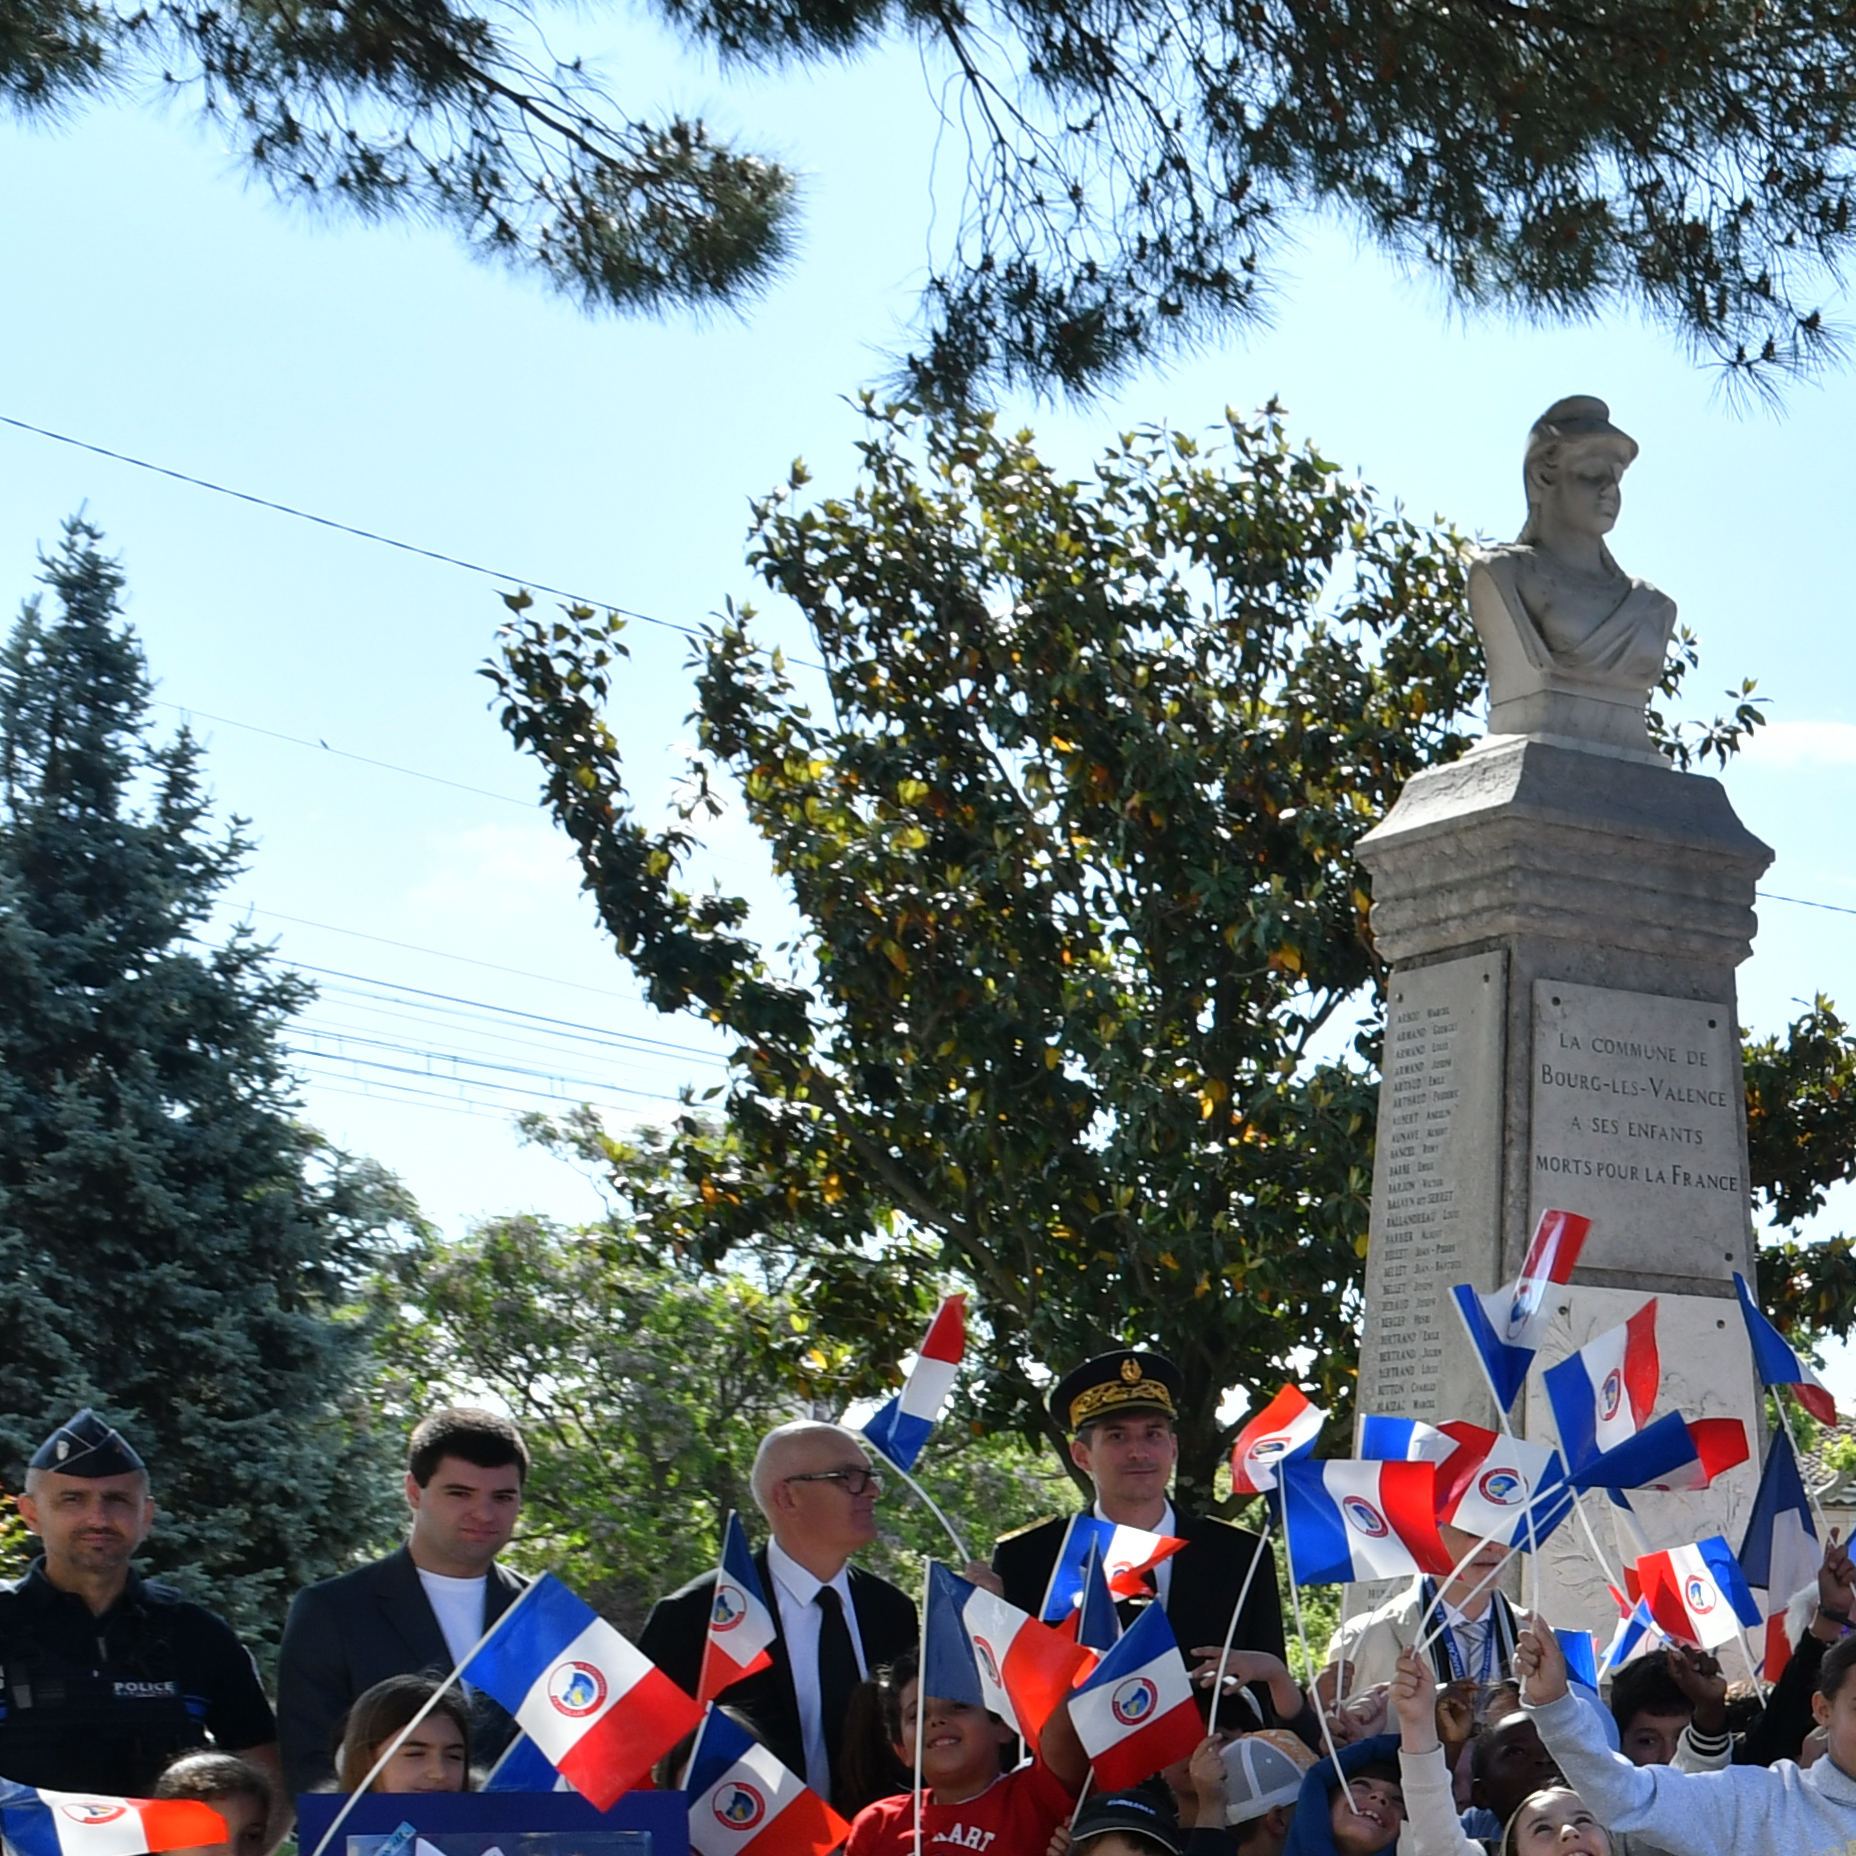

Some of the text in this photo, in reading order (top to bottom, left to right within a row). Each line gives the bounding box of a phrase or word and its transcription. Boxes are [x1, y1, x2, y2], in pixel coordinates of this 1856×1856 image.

[1560, 1032, 1708, 1067] LA COMMUNE DE
[1592, 1117, 1619, 1135] SES
[1628, 1121, 1703, 1145] ENFANTS
[1536, 1155, 1738, 1192] MORTS POUR LA FRANCE
[113, 1681, 174, 1692] POLICE
